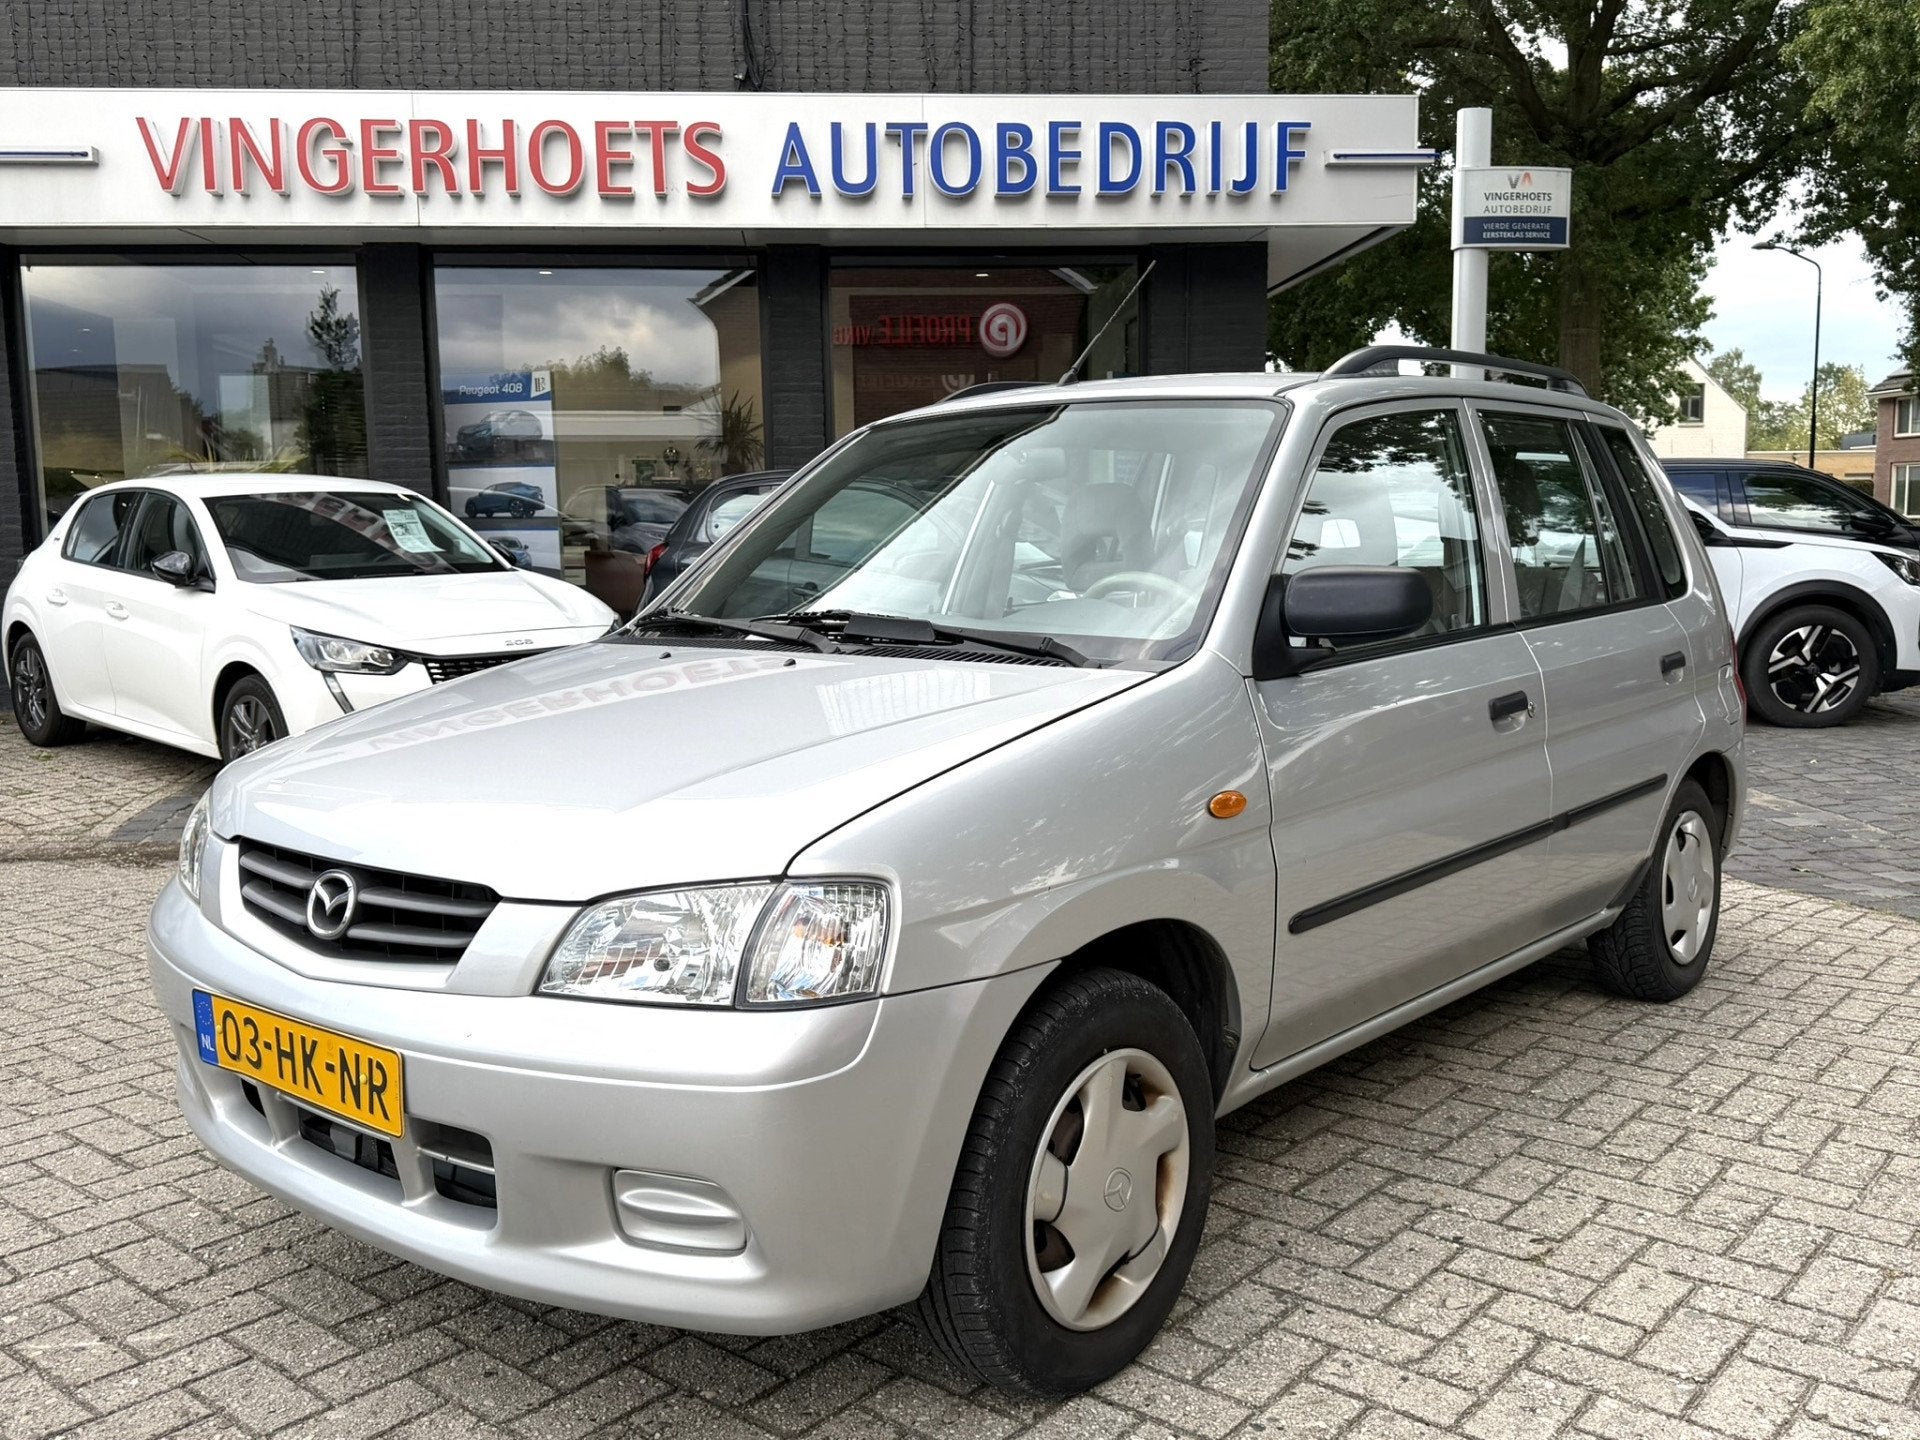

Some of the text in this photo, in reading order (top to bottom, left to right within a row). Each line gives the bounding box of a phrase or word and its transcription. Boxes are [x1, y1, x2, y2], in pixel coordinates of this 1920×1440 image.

[136, 117, 1312, 198] VINGERHOETS AUTOBEDRIJF
[1484, 192, 1552, 201] VINGERHOETS
[1483, 205, 1552, 214] AUTOBEDRIJF
[1483, 222, 1551, 230] VIERDE GENERATIE
[1482, 231, 1551, 239] EERSTEKLAS SERVICE
[459, 384, 500, 397] Peugeot
[501, 383, 523, 394] 408
[201, 1033, 215, 1052] NL
[221, 1009, 390, 1121] 03-HK-NR
